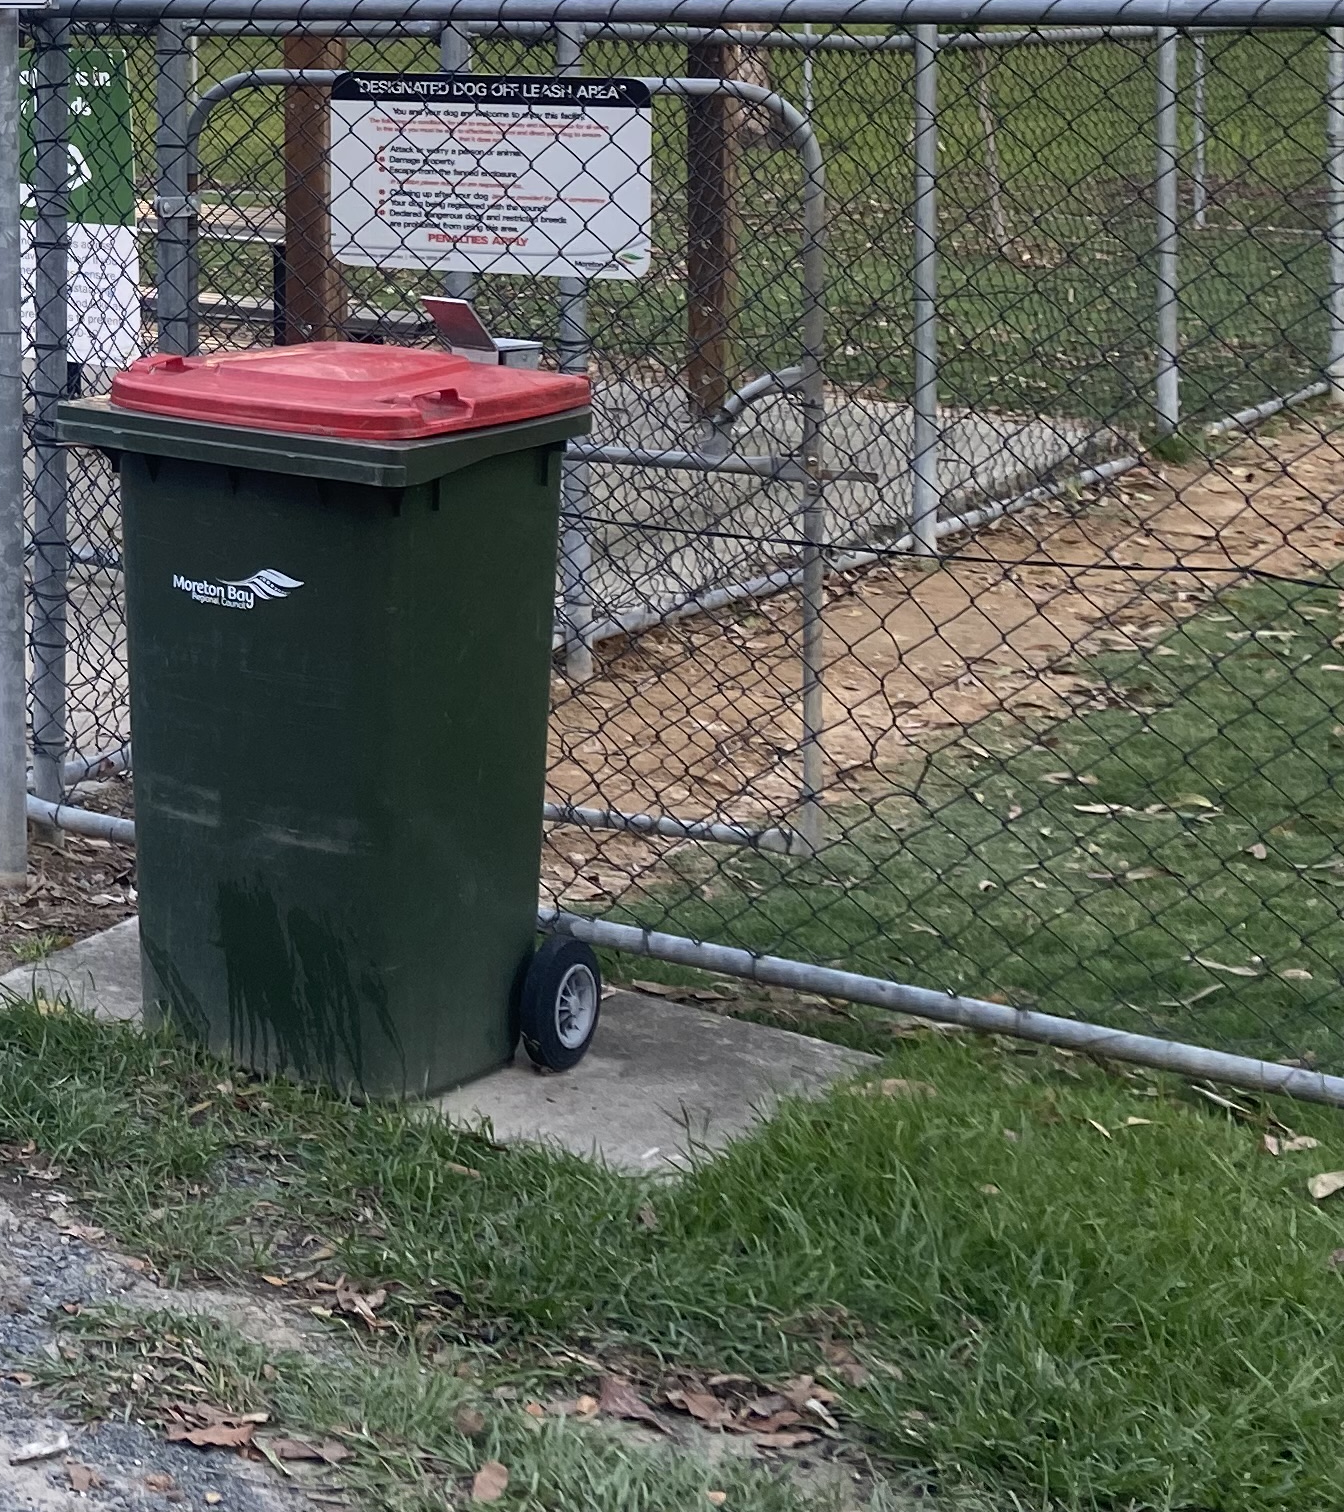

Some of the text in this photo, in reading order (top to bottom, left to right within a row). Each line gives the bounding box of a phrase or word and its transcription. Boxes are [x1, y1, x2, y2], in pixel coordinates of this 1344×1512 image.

[453, 82, 487, 96] DOG
[492, 83, 519, 96] OFF
[523, 84, 572, 98] LEASH
[443, 109, 458, 118] dog
[390, 156, 420, 165] Damage
[440, 168, 450, 176] the
[422, 190, 432, 198] up
[474, 192, 488, 201] dog
[390, 209, 422, 218] Declared
[428, 234, 488, 245] PENALTIES
[173, 574, 254, 608] Moreton Bay
[192, 592, 246, 610] Regional Council
